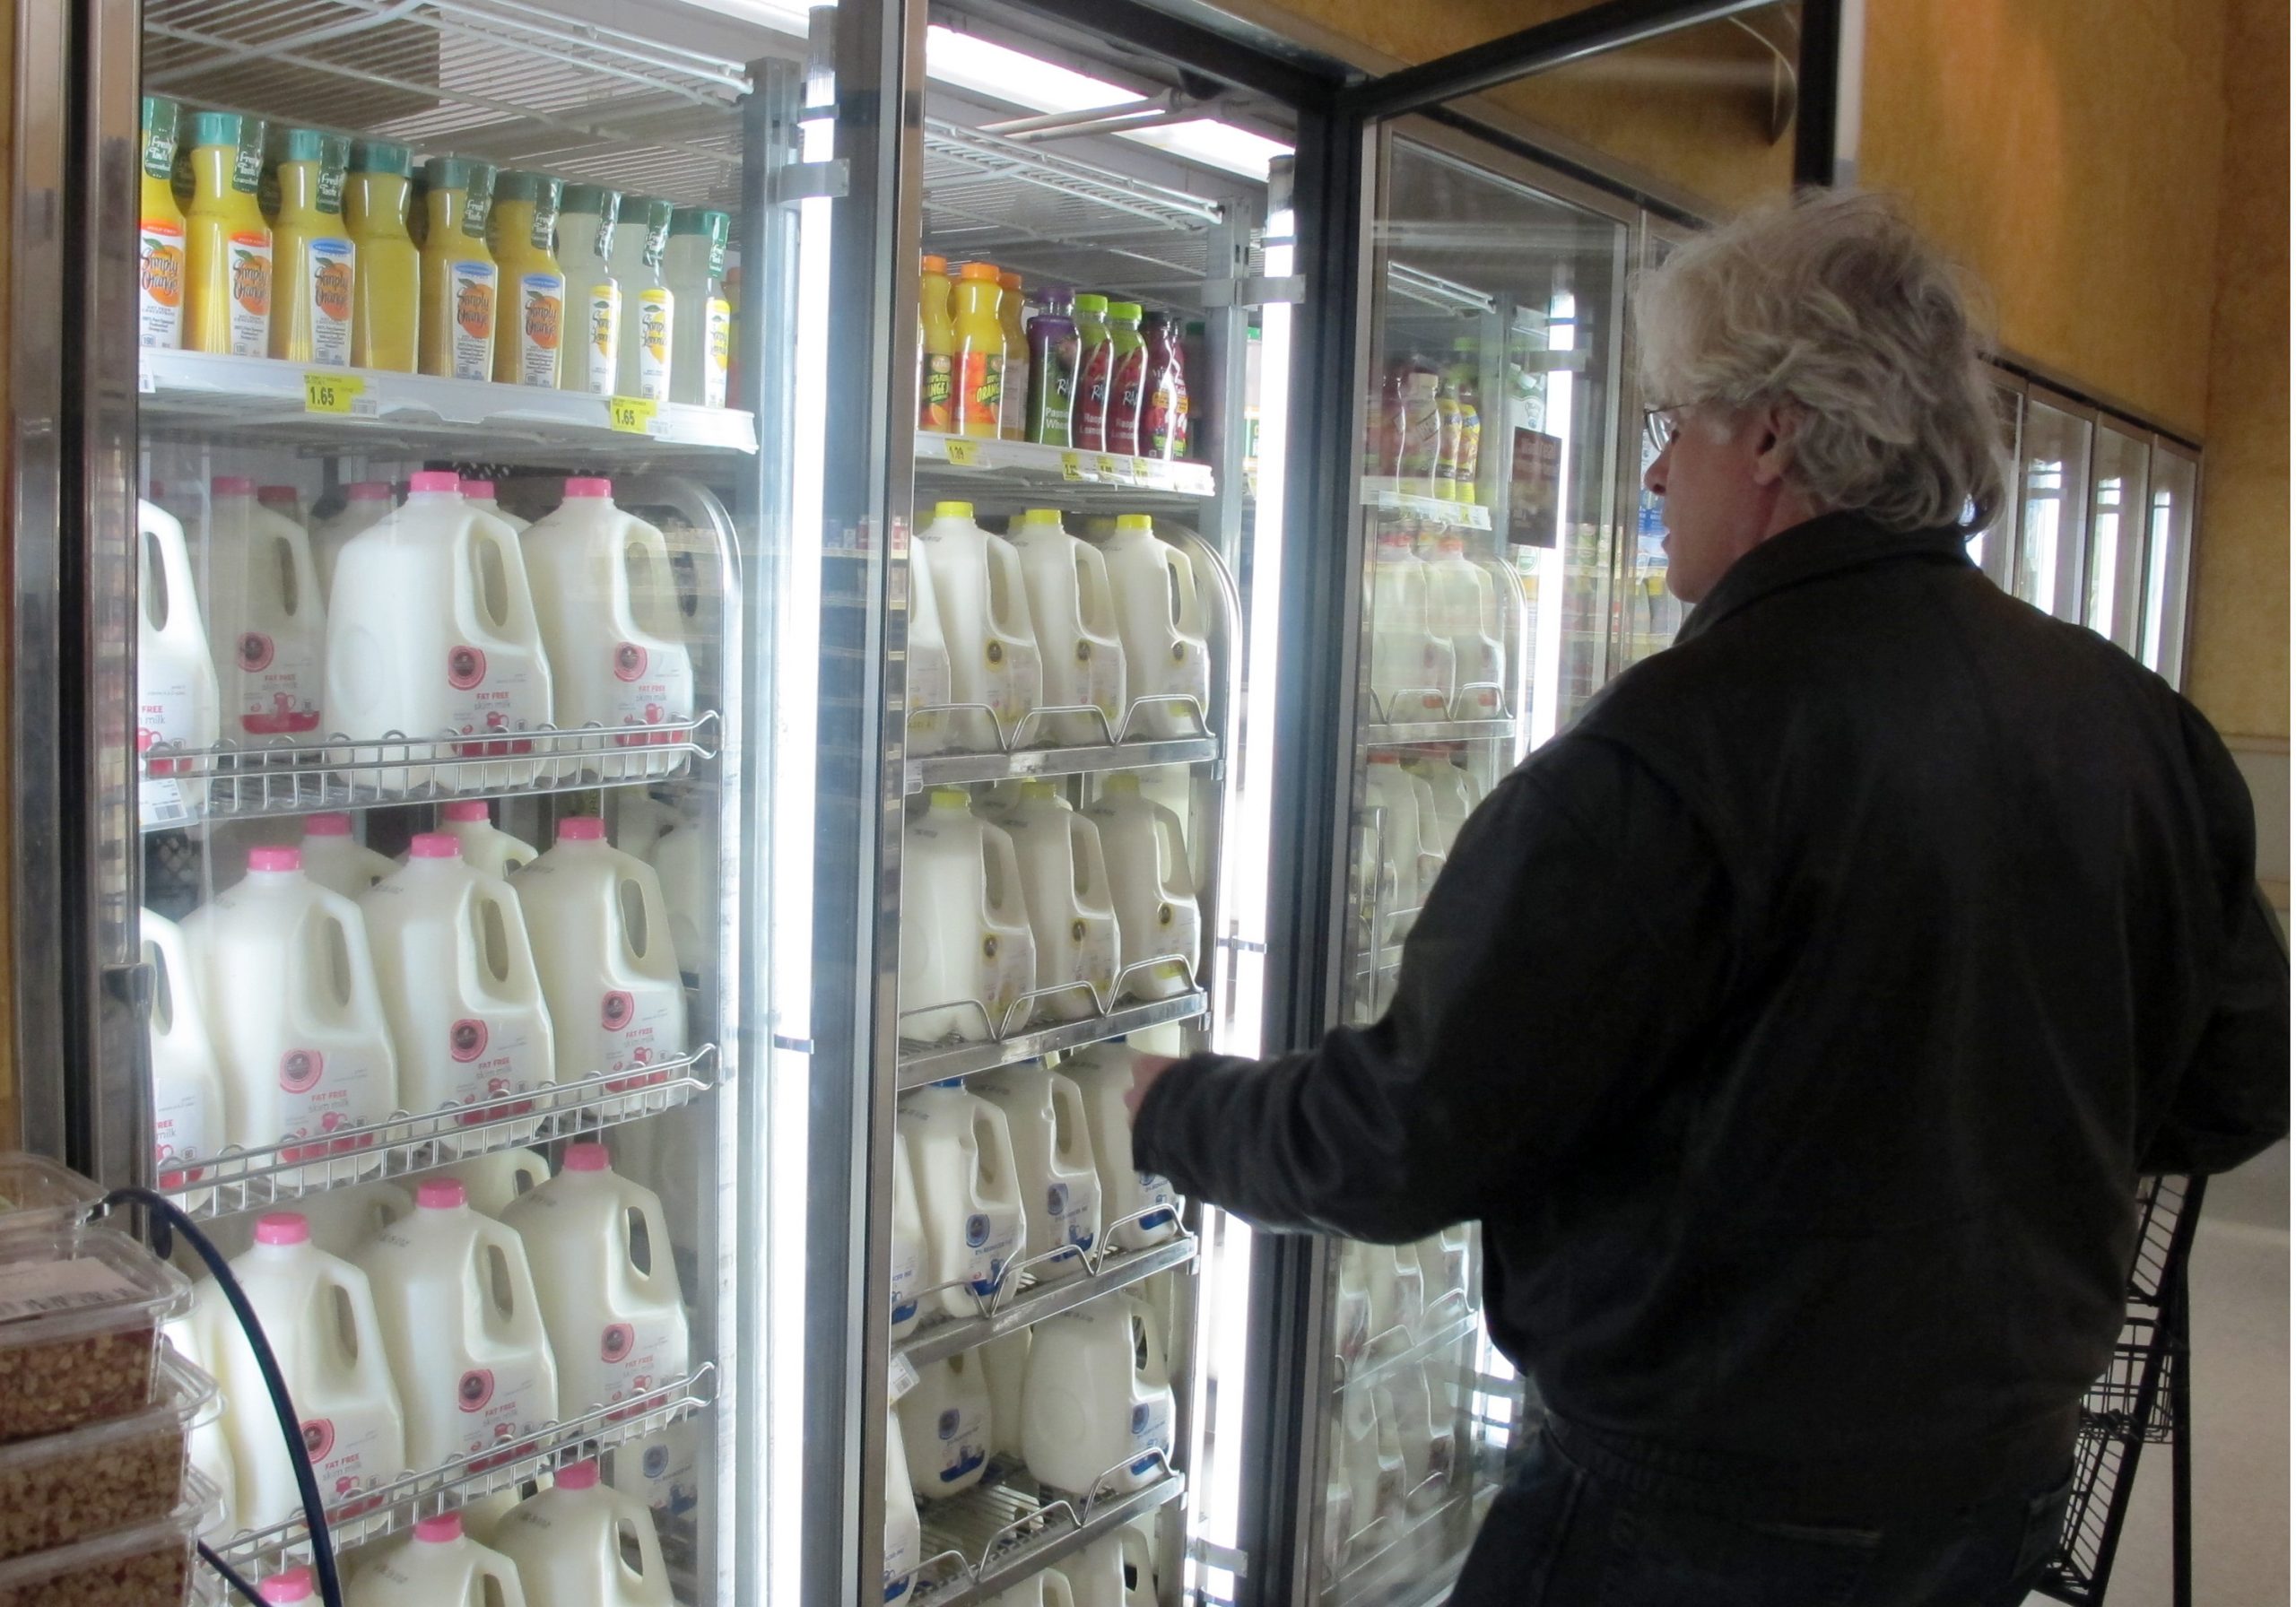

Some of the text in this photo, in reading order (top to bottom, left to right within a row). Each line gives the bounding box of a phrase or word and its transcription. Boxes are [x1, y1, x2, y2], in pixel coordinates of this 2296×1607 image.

[141, 248, 178, 276] Simply
[233, 258, 267, 287] Simply
[315, 265, 349, 290] Simply
[142, 270, 178, 296] Orange
[234, 278, 267, 305] Orange
[316, 285, 348, 309] Orange
[457, 287, 490, 310] Simply
[457, 304, 489, 327] Orange
[526, 299, 558, 323] Simply
[526, 316, 557, 338] Orange
[310, 386, 335, 406] 1.65
[615, 407, 636, 426] 1.65
[491, 691, 509, 699] FREE
[651, 684, 665, 692] FREE
[142, 705, 163, 714] FREE
[626, 1027, 653, 1038] FAT FREE
[479, 1056, 510, 1069] FAT FREE
[311, 1090, 347, 1102] FAT FREE
[157, 1118, 174, 1129] REE
[625, 1353, 654, 1369] FAT FREE
[485, 1401, 517, 1418] FAT FREE
[326, 1453, 360, 1470] FAT FREE
